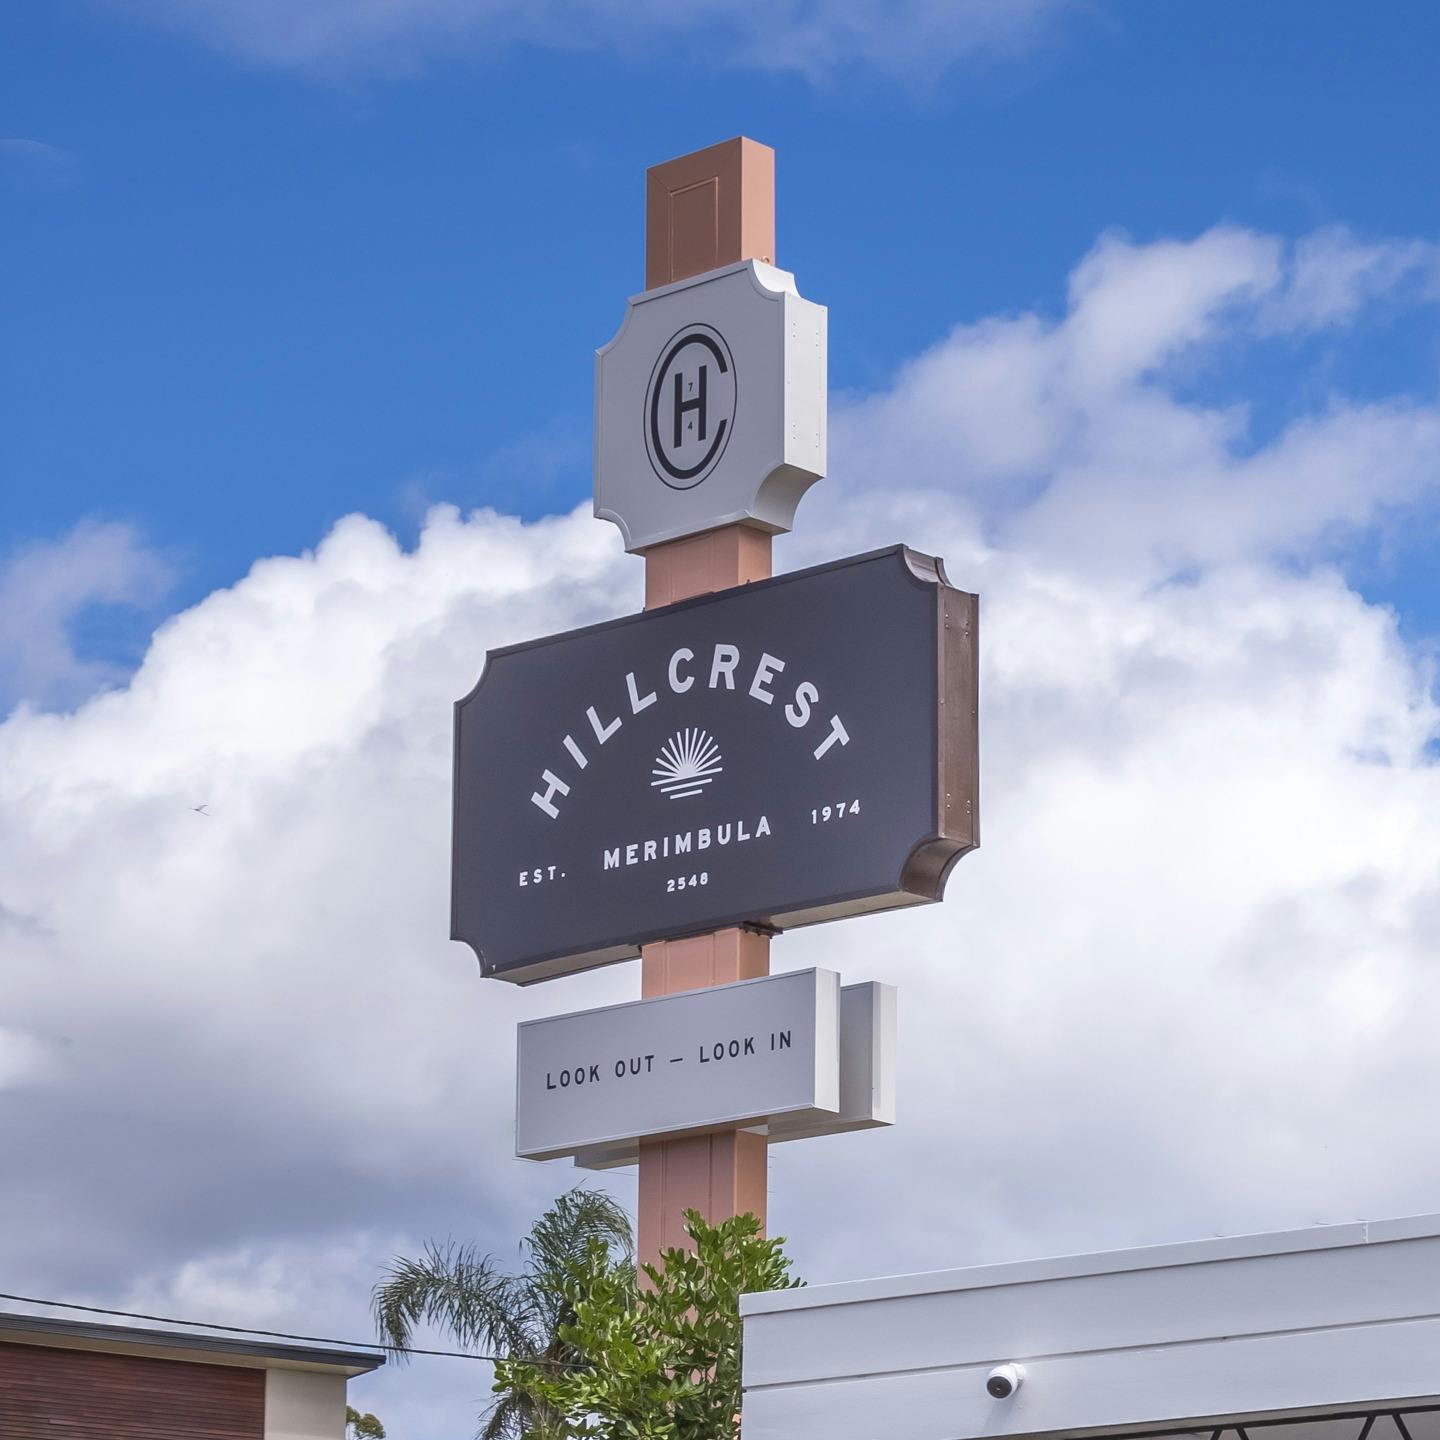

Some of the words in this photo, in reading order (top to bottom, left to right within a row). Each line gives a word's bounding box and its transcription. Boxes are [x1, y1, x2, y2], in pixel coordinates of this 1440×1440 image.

[688, 382, 694, 392] 7
[687, 421, 693, 431] 4
[531, 643, 850, 819] HILLCREST
[519, 866, 566, 887] EST.
[603, 816, 771, 870] MERIMBULA
[811, 800, 861, 824] 1974
[666, 872, 709, 893] 2548
[546, 1064, 600, 1090] LOOK
[614, 1055, 655, 1078] OUT
[699, 1037, 756, 1063] LOOK
[770, 1030, 792, 1050] IN
